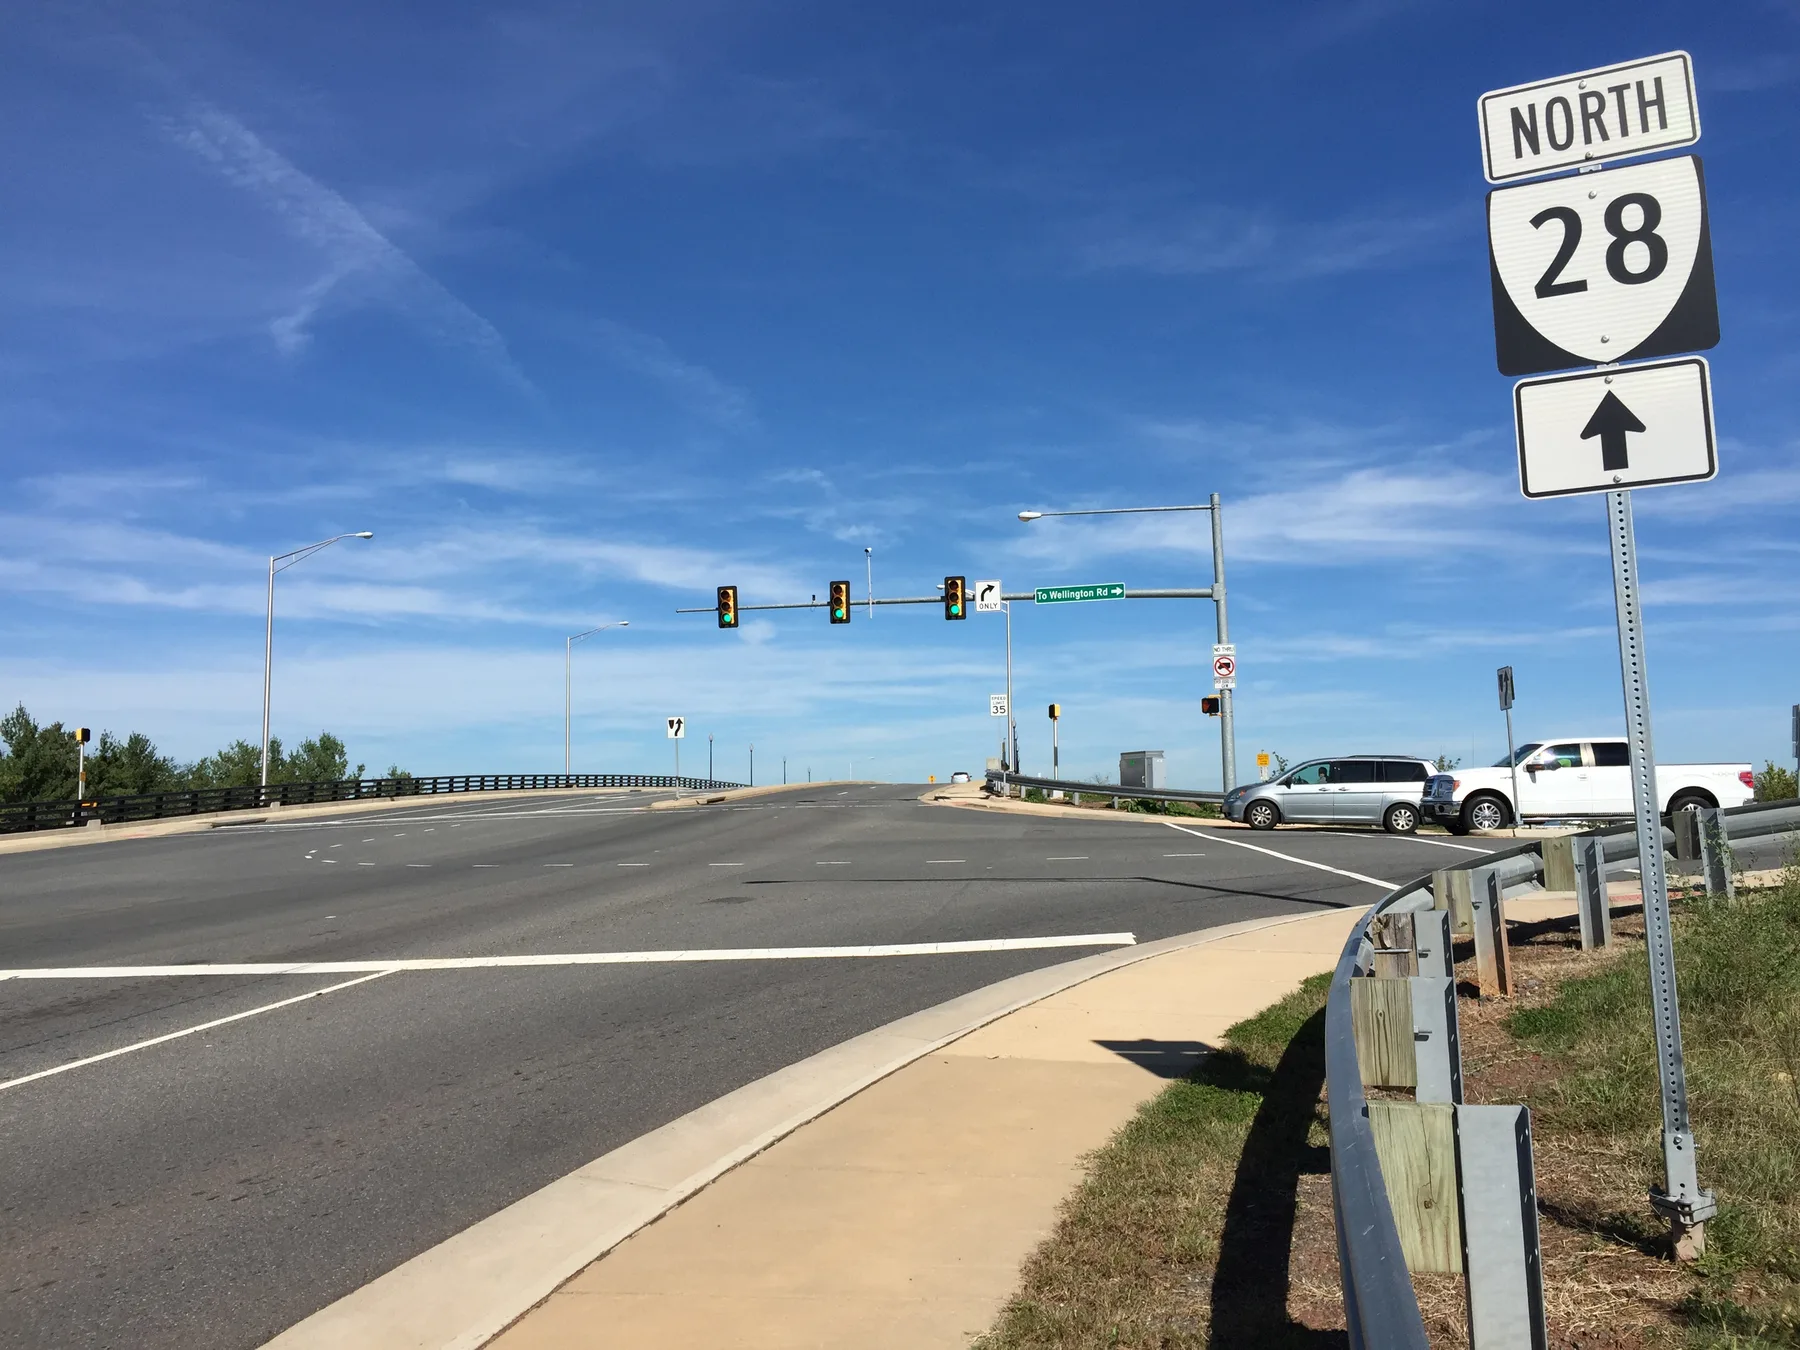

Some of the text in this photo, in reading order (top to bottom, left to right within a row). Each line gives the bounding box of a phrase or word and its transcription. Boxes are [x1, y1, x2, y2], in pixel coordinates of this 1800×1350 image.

[1510, 76, 1668, 159] NORTH
[1528, 192, 1668, 299] 28
[1037, 587, 1108, 600] To Wellington Rd
[979, 602, 998, 610] ONLY
[992, 705, 1006, 714] 35
